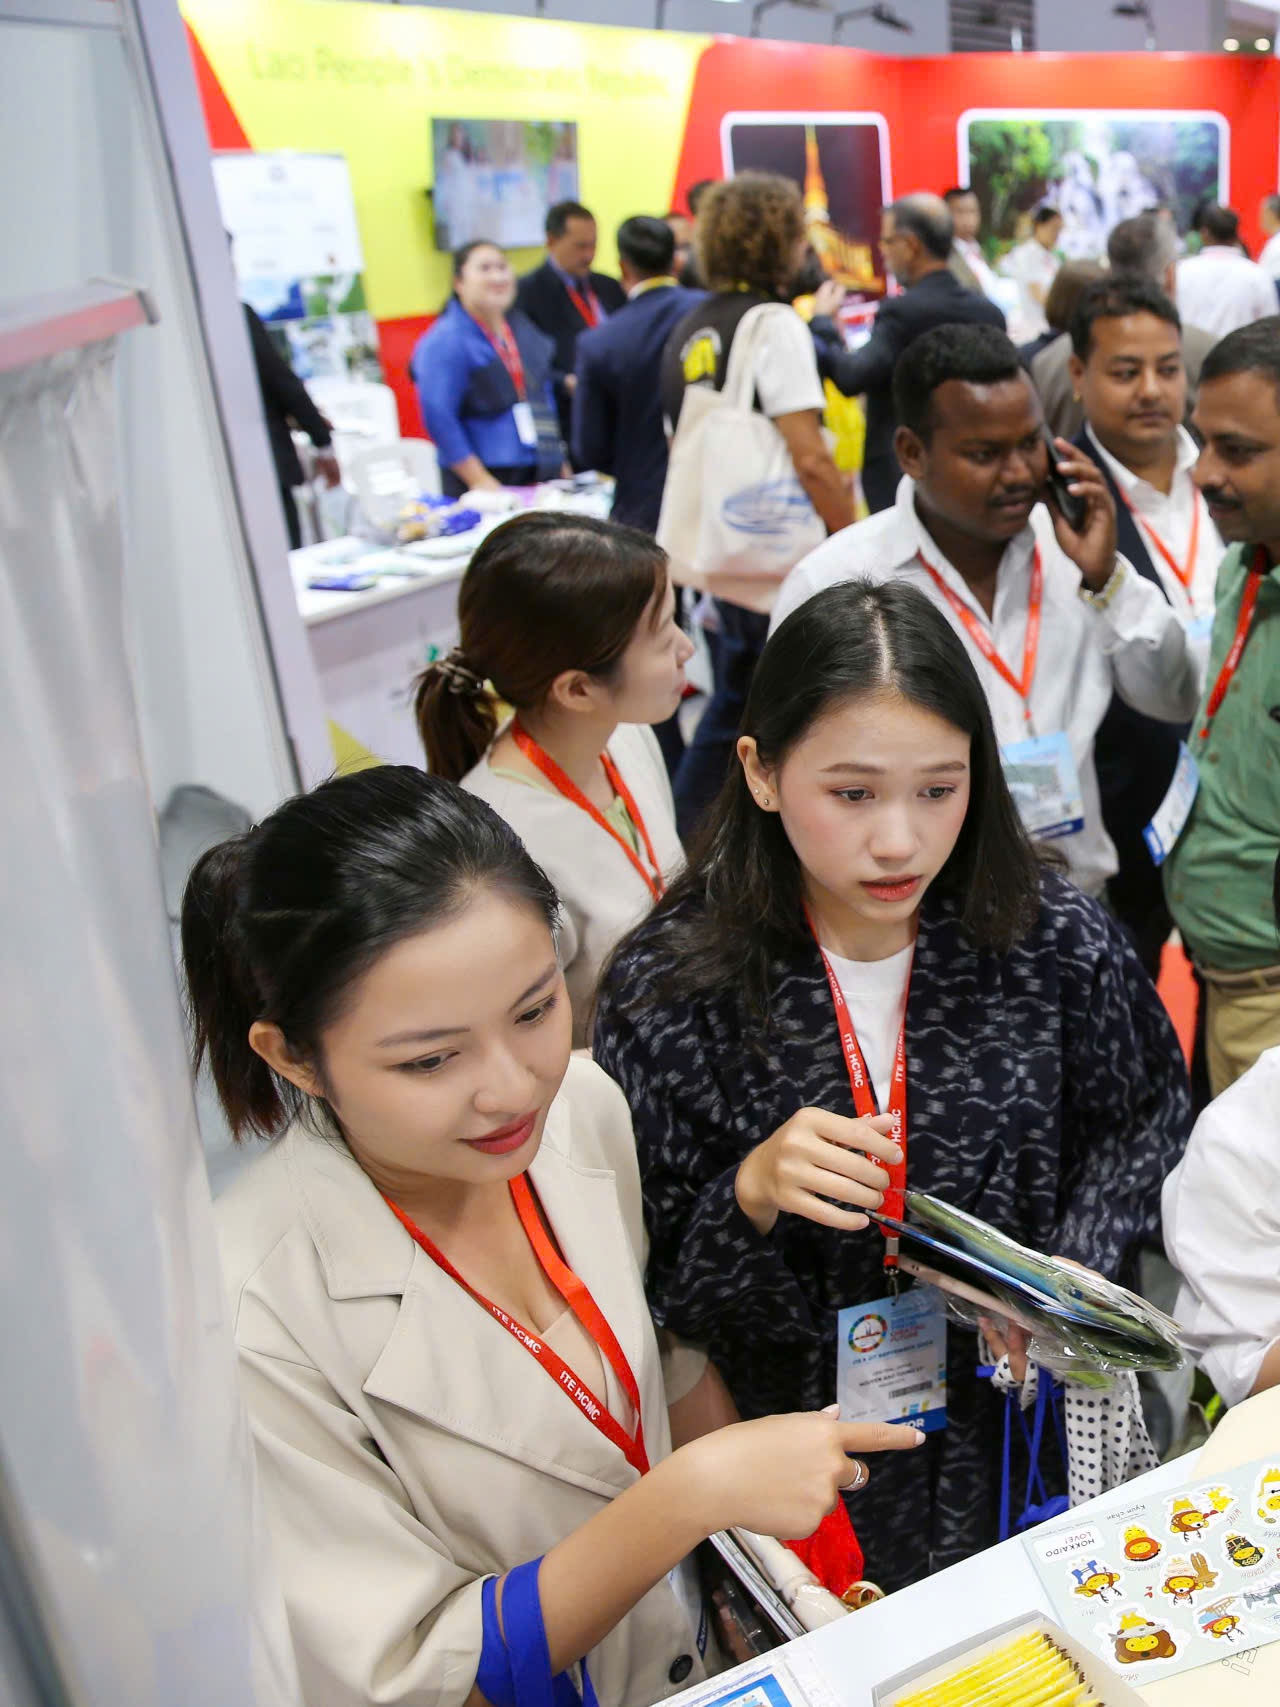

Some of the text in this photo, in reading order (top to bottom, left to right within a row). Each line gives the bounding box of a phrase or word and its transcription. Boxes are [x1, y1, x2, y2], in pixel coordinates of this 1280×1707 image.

[844, 1033, 864, 1088] ITE HCMC
[493, 1307, 542, 1354] ITE HCMC
[560, 1371, 600, 1420] ITE HCMC
[1046, 1538, 1095, 1557] HOKKAIDO
[1064, 1531, 1092, 1544] LOVE!
